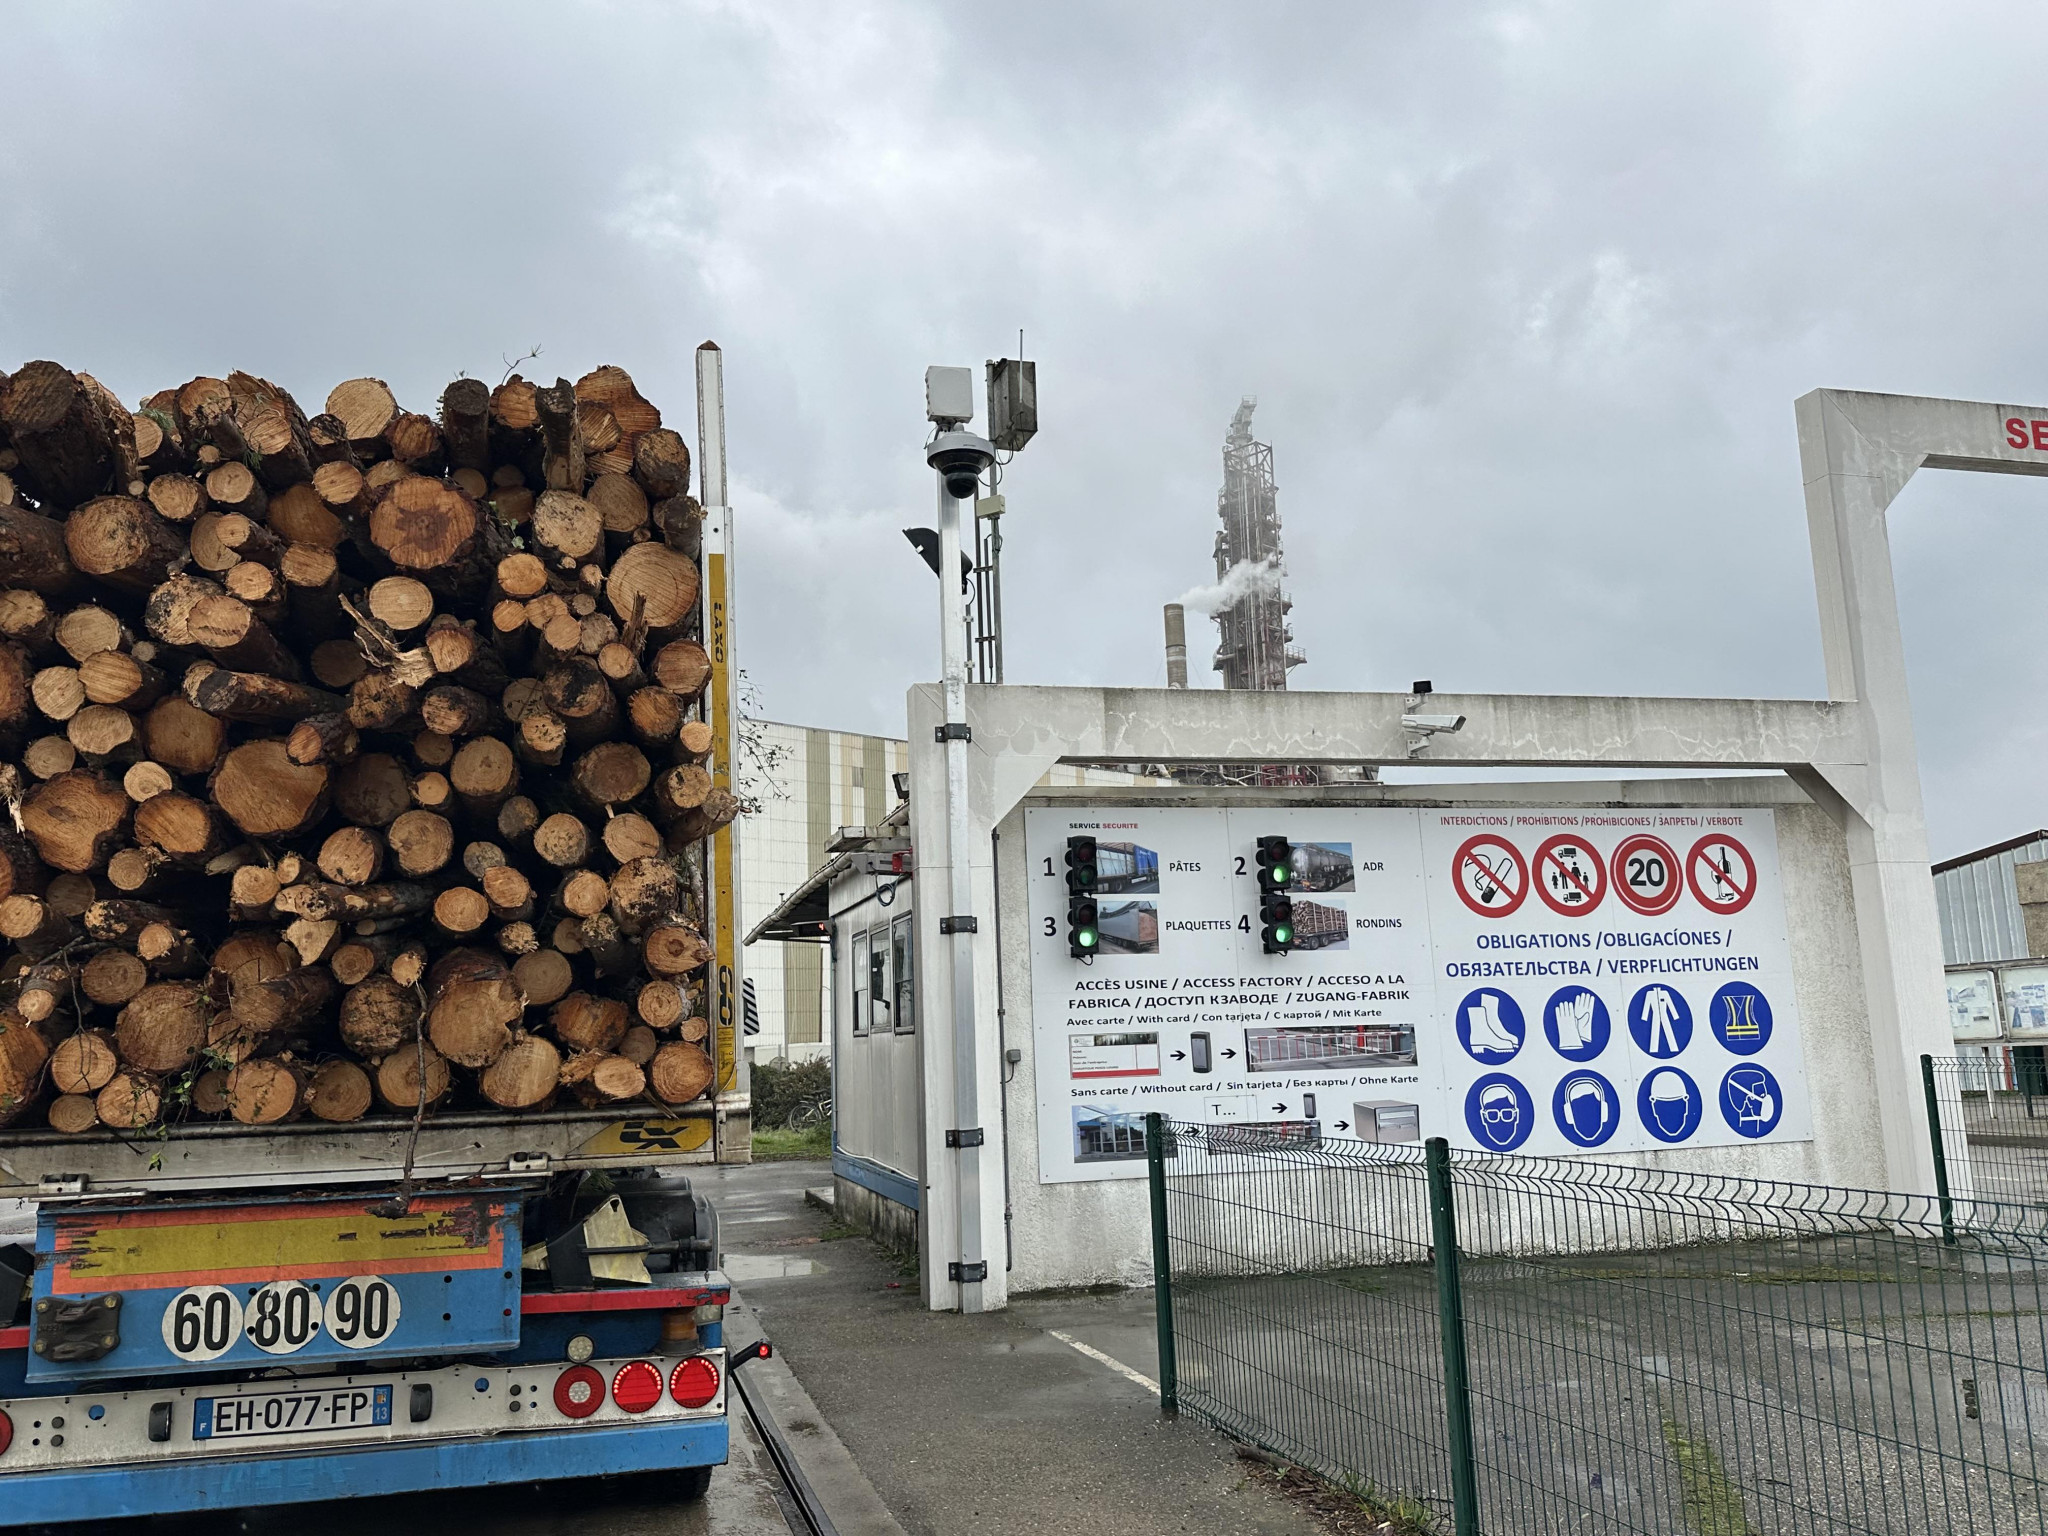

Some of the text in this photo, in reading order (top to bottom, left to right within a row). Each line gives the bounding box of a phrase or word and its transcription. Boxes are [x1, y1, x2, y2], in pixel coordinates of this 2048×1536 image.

[2005, 417, 2048, 451] SE
[1440, 816, 1508, 826] INTERDICTIONS
[1516, 816, 1579, 826] PROHIBITIONS
[1659, 817, 1698, 826] ЗАПРЕТЫ
[1706, 817, 1743, 826] VERBOTE
[1043, 857, 1055, 876] 1
[1169, 860, 1201, 872] PÂTES
[1234, 856, 1247, 875] 2
[1363, 862, 1384, 871] ADR
[1627, 857, 1665, 887] 20
[1043, 916, 1057, 937] 3
[1165, 920, 1231, 931] PLAQUETTES
[1238, 914, 1251, 934] 4
[1356, 919, 1402, 928] RONDINS
[1476, 933, 1591, 949] OBLIGATIONS
[1446, 960, 1592, 977] ОБЯЗАТЕЛЬСТВА
[1607, 956, 1759, 974] VERPFLICHTUNGEN
[1075, 978, 1121, 991] ACCÈS
[1125, 979, 1168, 990] USINE
[1183, 978, 1235, 988] ACCESS
[1239, 977, 1303, 987] FACTORY
[1317, 975, 1371, 985] ACCESO
[1374, 975, 1385, 984] A
[1388, 974, 1405, 984] LA
[1068, 998, 1131, 1009] FABRICA
[1295, 991, 1410, 1003] ZUGANG-FABRIK
[1066, 1017, 1094, 1026] Avec
[1096, 1017, 1125, 1025] carte
[1136, 1015, 1164, 1024] With
[1166, 1013, 1190, 1023] card
[1201, 1013, 1222, 1021] Con
[1226, 1012, 1262, 1022] tarjeta
[1283, 1010, 1321, 1020] картой
[1333, 1009, 1351, 1018] Mit
[1354, 1009, 1382, 1017] Karte
[1071, 1088, 1097, 1097] Sans
[1100, 1087, 1128, 1096] carte
[1140, 1084, 1186, 1094] Without
[1189, 1082, 1213, 1092] card
[1227, 1082, 1243, 1090] Sin
[1247, 1080, 1282, 1090] tarjeta
[1315, 1079, 1348, 1088] карты
[1359, 1076, 1388, 1085] Ohne
[1390, 1075, 1419, 1084] Karte
[173, 1282, 389, 1353] 60 80 90
[216, 1392, 368, 1432] EH-077-FP
[375, 1407, 388, 1420] 13
[199, 1422, 207, 1431] F
